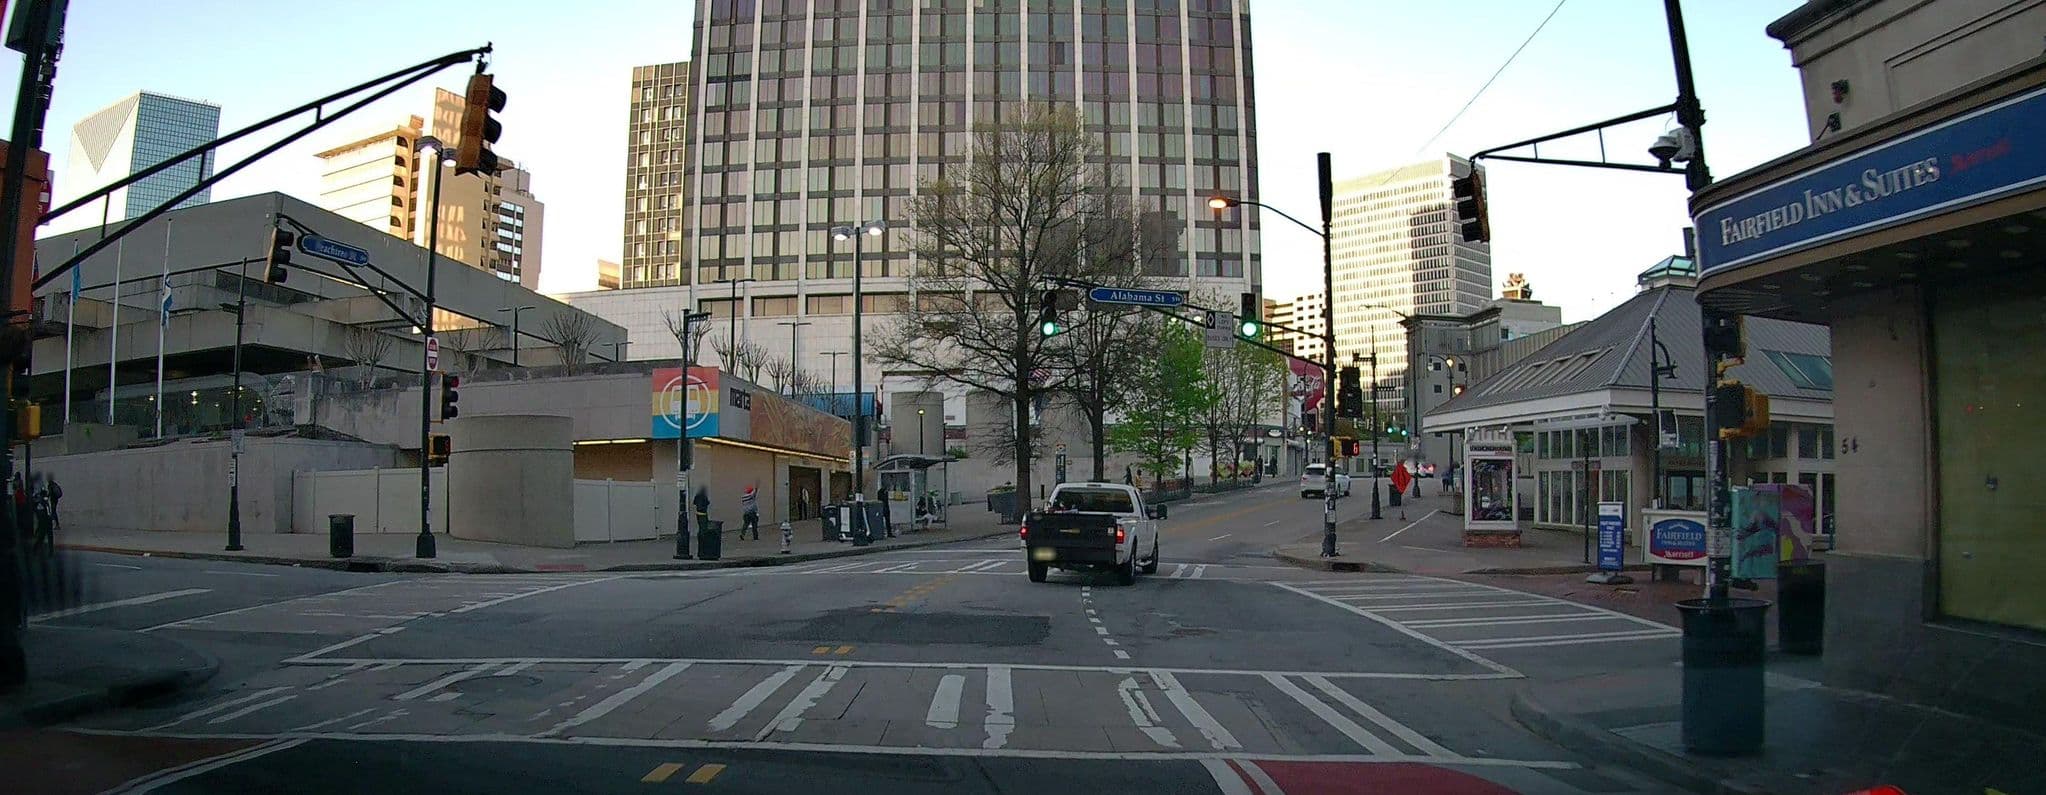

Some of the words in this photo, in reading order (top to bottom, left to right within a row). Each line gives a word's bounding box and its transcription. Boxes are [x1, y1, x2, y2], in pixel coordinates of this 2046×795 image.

[1720, 202, 1804, 246] FAIRFIELD
[1805, 187, 1843, 219] INN
[1842, 184, 1864, 207] &
[1861, 157, 1940, 201] SUITES
[1110, 290, 1152, 302] Alabama
[1155, 293, 1165, 303] St
[730, 387, 751, 411] marta
[1353, 442, 1358, 454] 6
[1841, 436, 1858, 455] 54
[1656, 528, 1702, 540] FAIRFIELD
